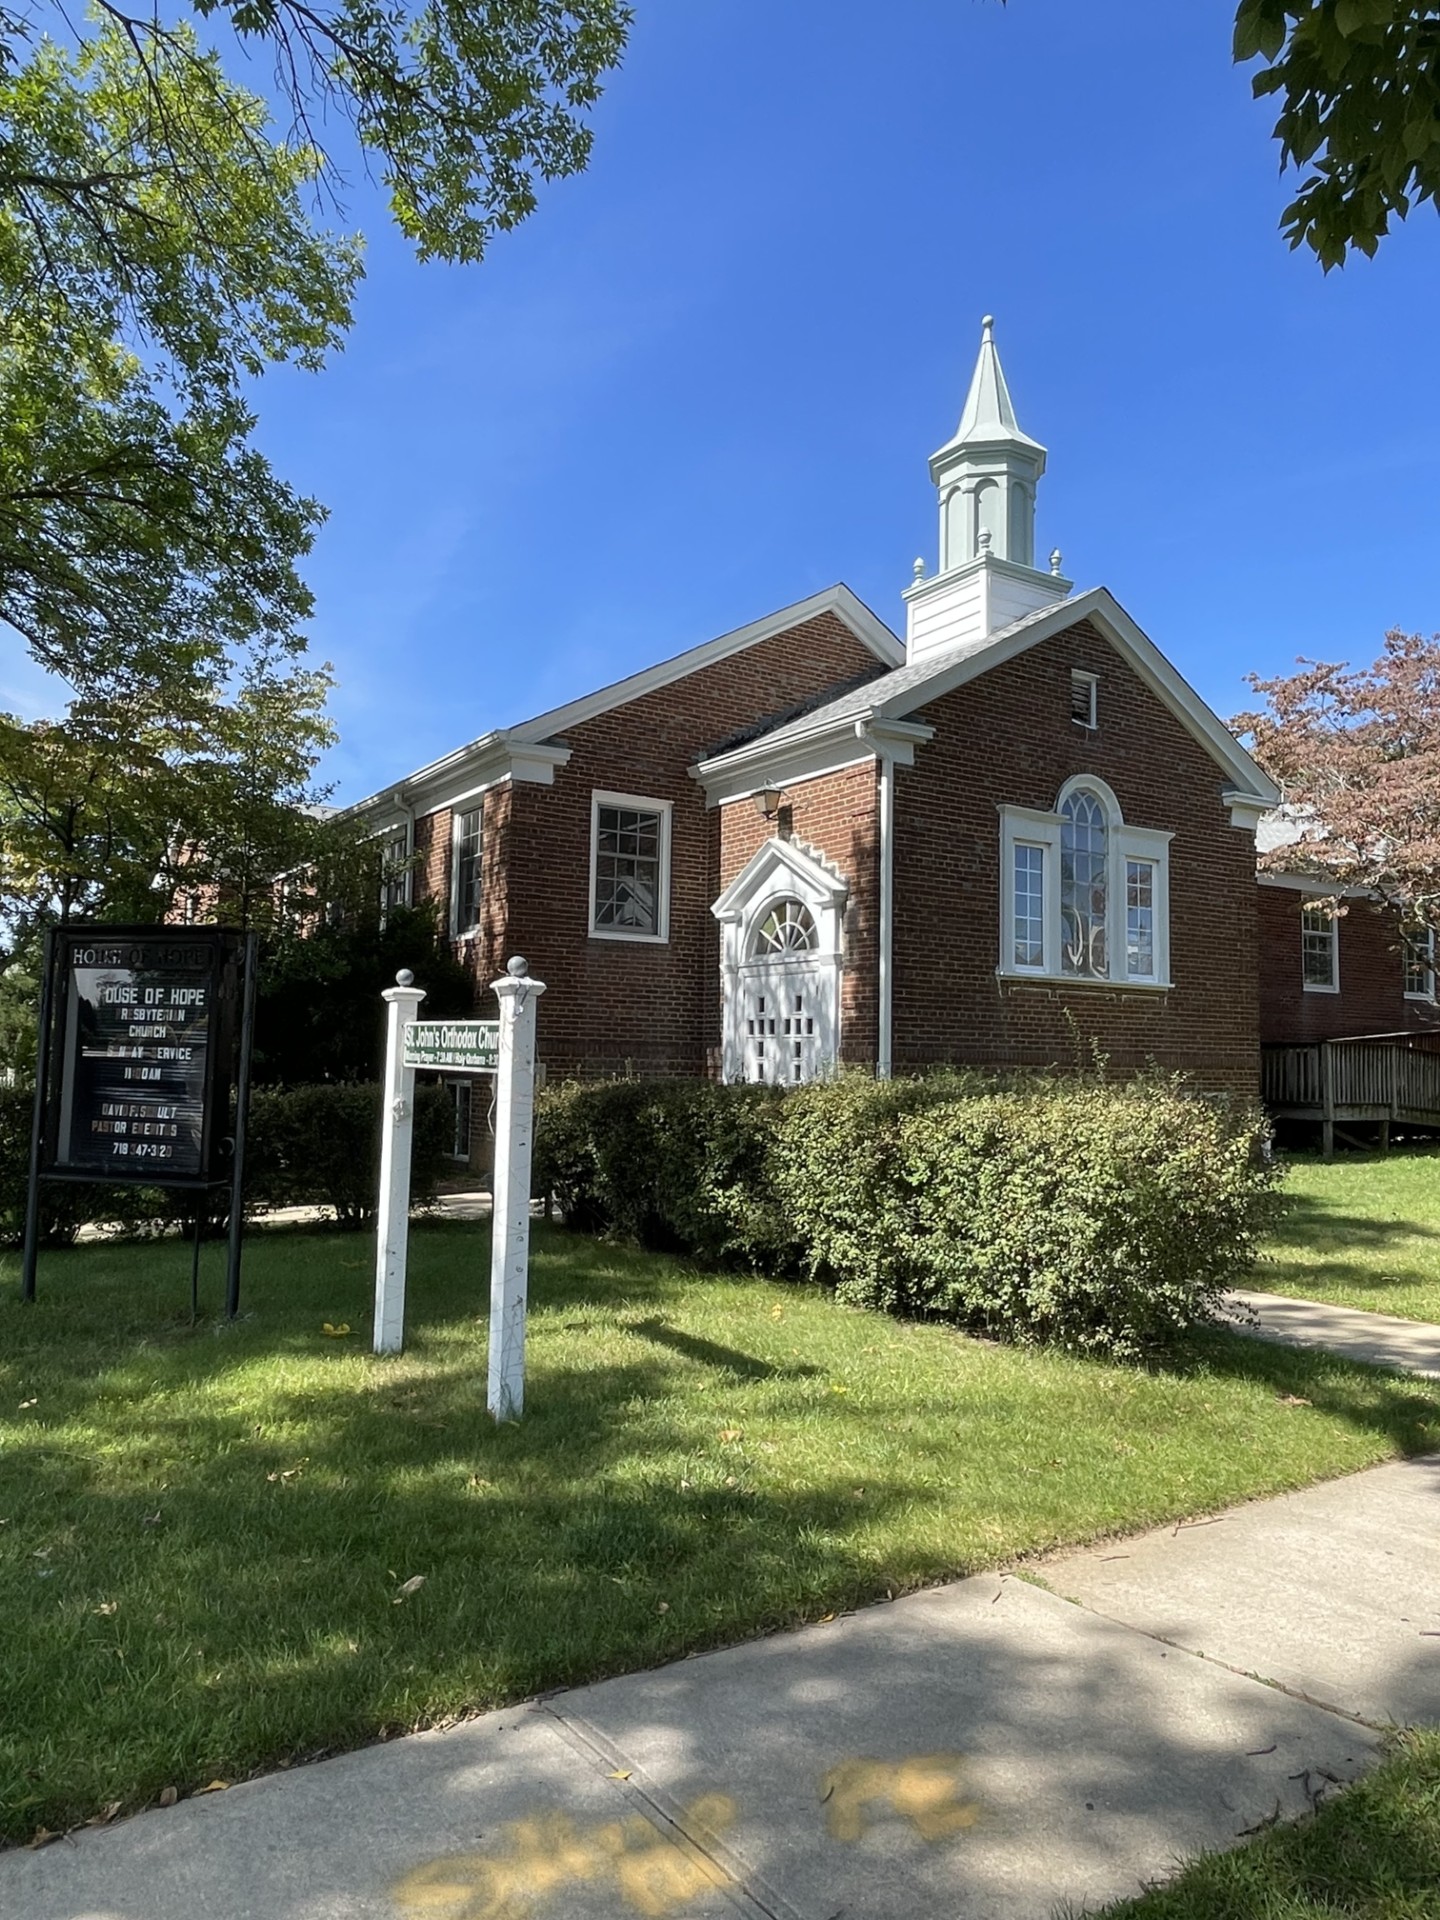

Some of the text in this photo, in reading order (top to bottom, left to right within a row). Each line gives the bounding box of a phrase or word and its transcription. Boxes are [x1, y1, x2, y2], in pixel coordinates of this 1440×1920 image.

[144, 988, 165, 1005] OF
[170, 988, 206, 1006] HOPE
[128, 1024, 166, 1038] CHURCH
[415, 1026, 440, 1048] John's
[441, 1026, 477, 1049] Orthodox
[106, 1044, 144, 1058] SNAY
[112, 1142, 129, 1155] 718
